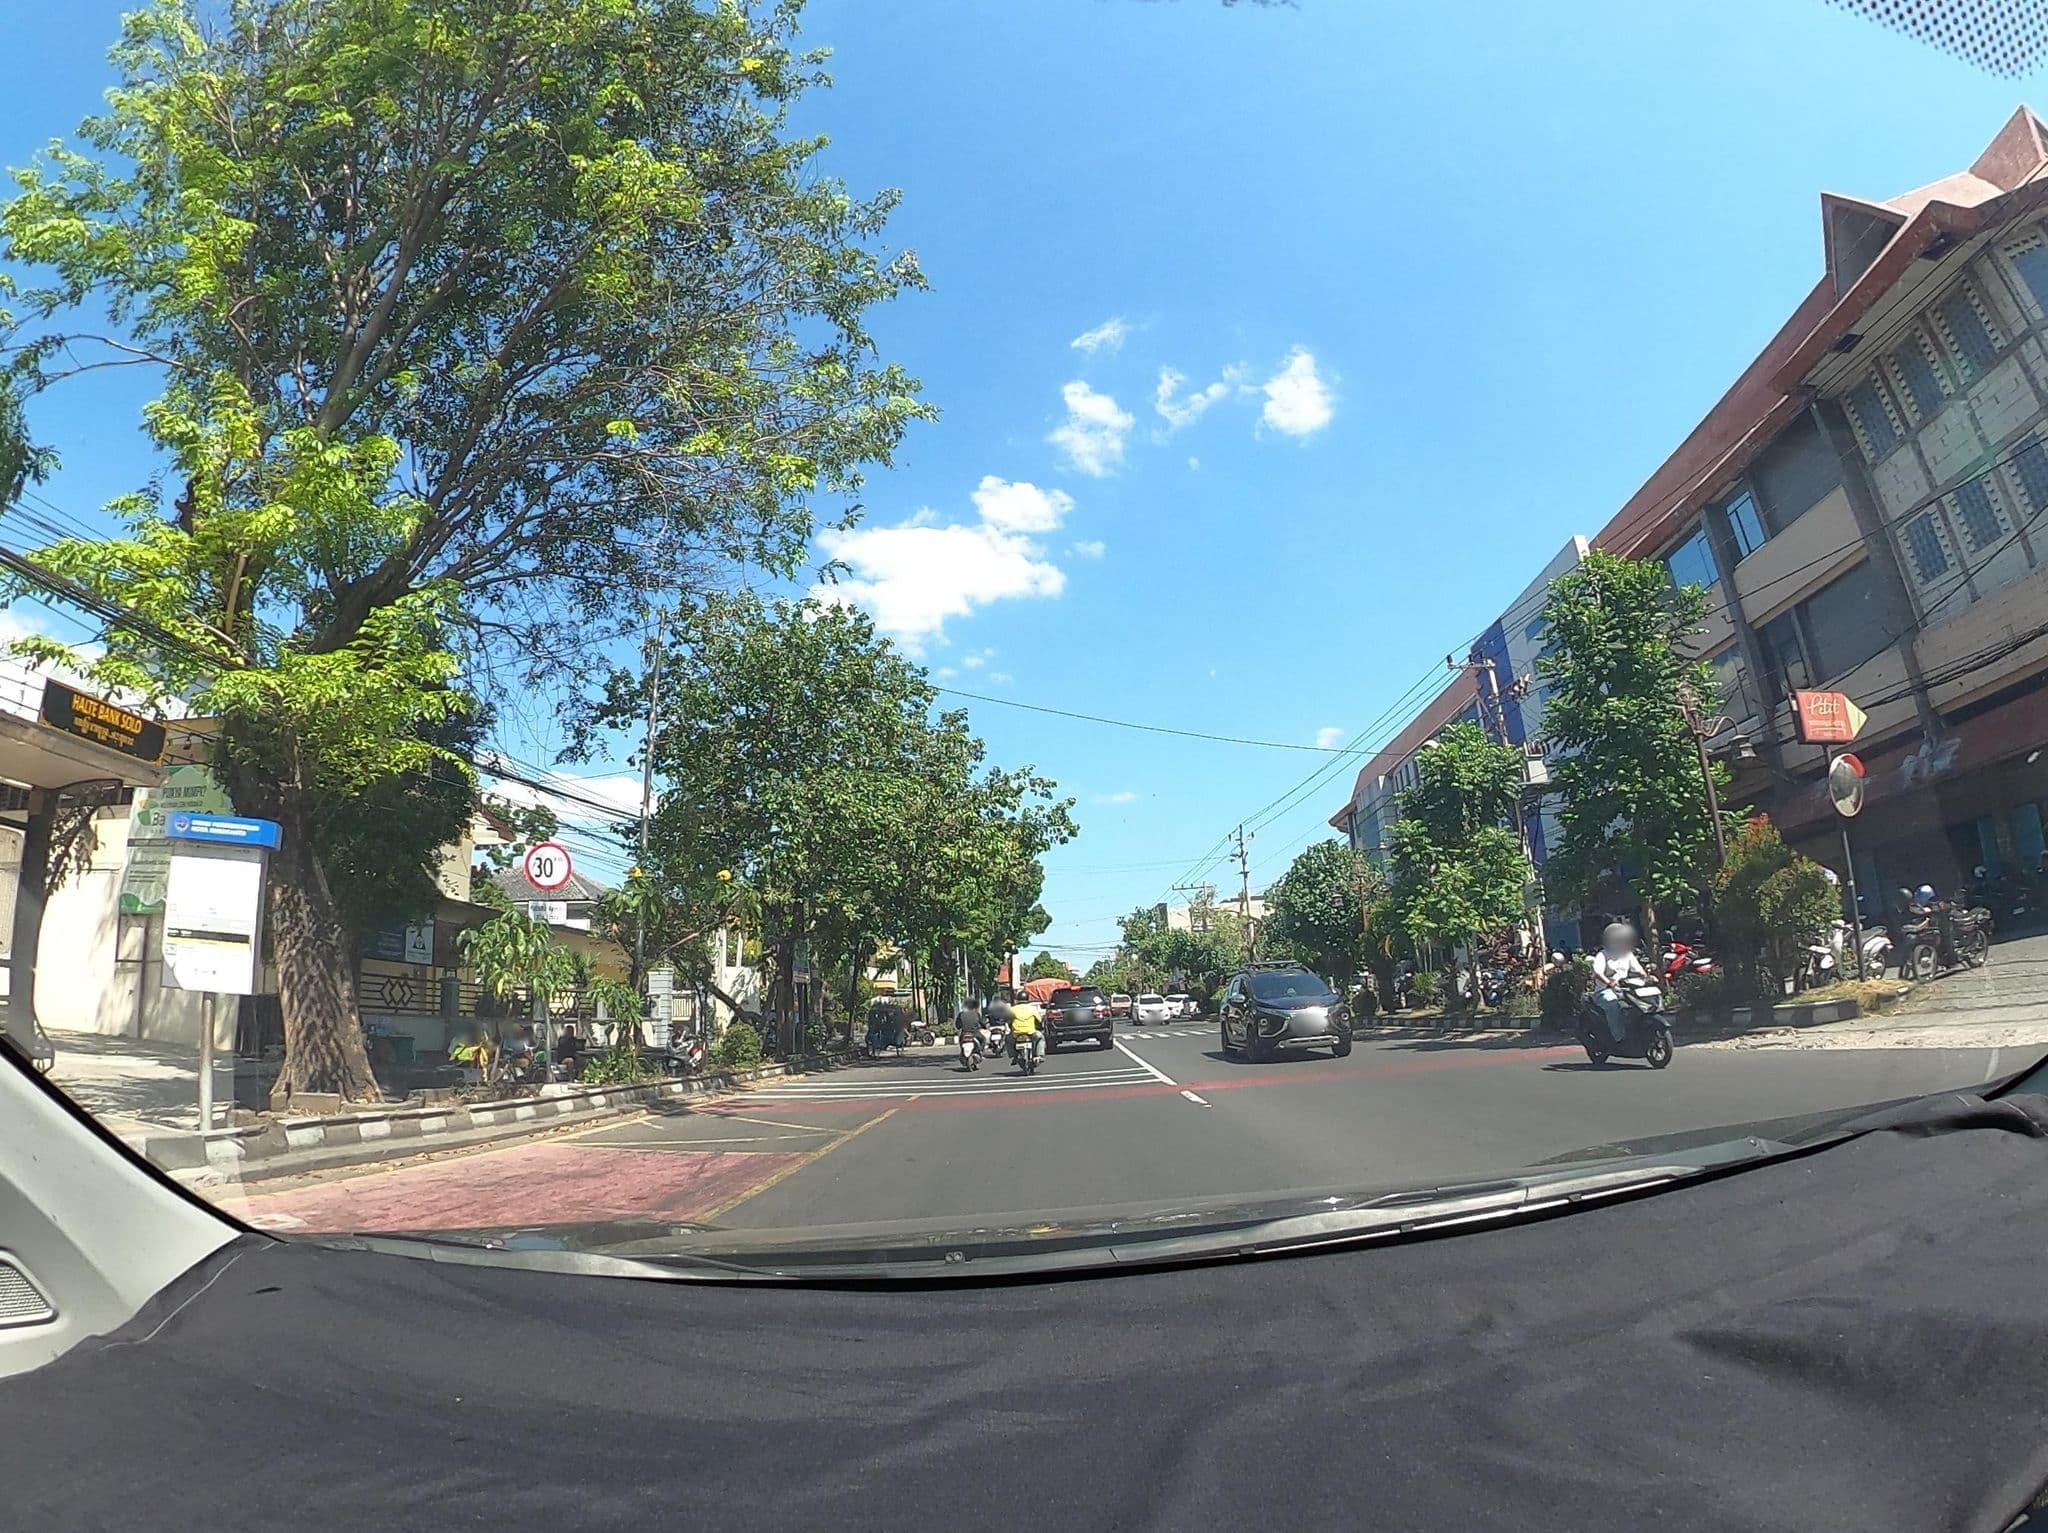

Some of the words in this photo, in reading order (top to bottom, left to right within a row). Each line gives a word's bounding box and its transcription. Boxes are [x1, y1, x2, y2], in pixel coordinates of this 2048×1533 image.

[71, 693, 98, 718] HALTE
[98, 704, 121, 726] BANK
[120, 713, 142, 734] SOLO
[534, 857, 553, 878] 30
